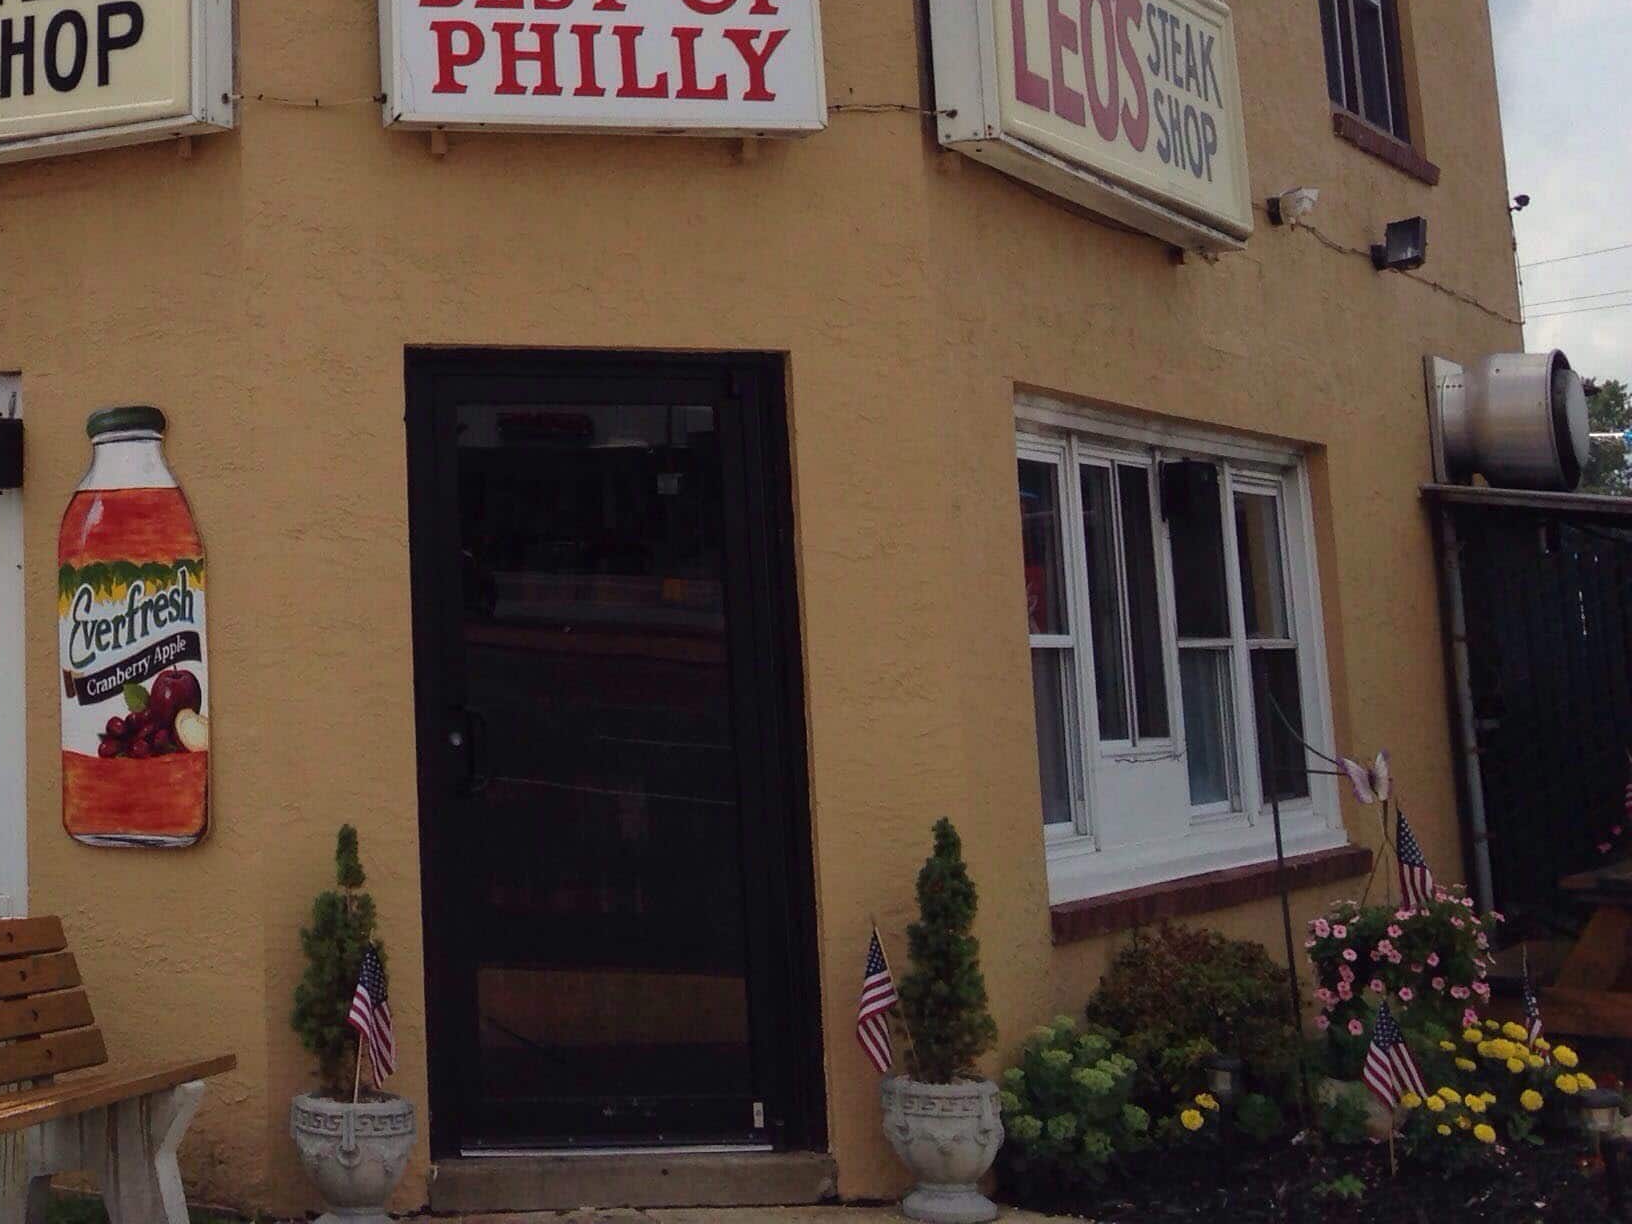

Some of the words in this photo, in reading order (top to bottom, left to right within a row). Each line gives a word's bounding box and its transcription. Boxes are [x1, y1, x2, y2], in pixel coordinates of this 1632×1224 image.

[429, 20, 791, 102] PHILLY
[1145, 2, 1224, 110] STEAK
[1153, 87, 1218, 183] SHOP
[69, 569, 195, 669] Everfresh
[86, 654, 152, 697] Cranberry
[153, 634, 188, 665] Apple
